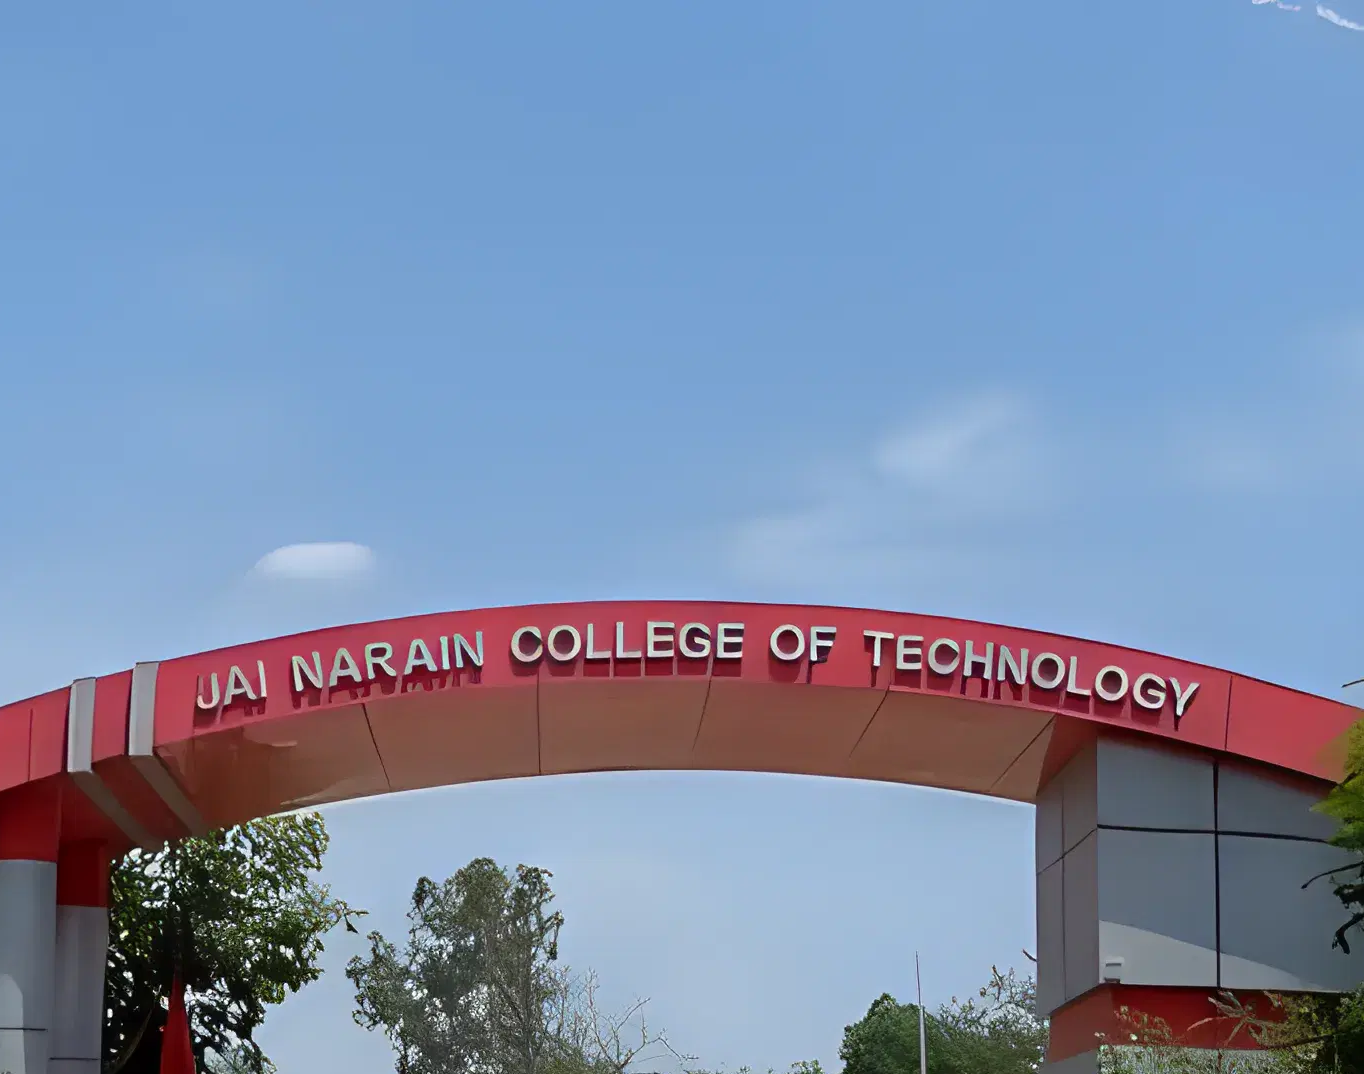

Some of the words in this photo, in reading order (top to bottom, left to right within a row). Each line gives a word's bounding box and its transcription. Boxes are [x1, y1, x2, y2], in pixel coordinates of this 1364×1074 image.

[196, 660, 267, 709] JAI
[291, 631, 484, 692] NARAIN
[510, 621, 745, 662] COLLEGE
[769, 624, 837, 661] OF
[863, 630, 1200, 717] TECHNOLOGY
